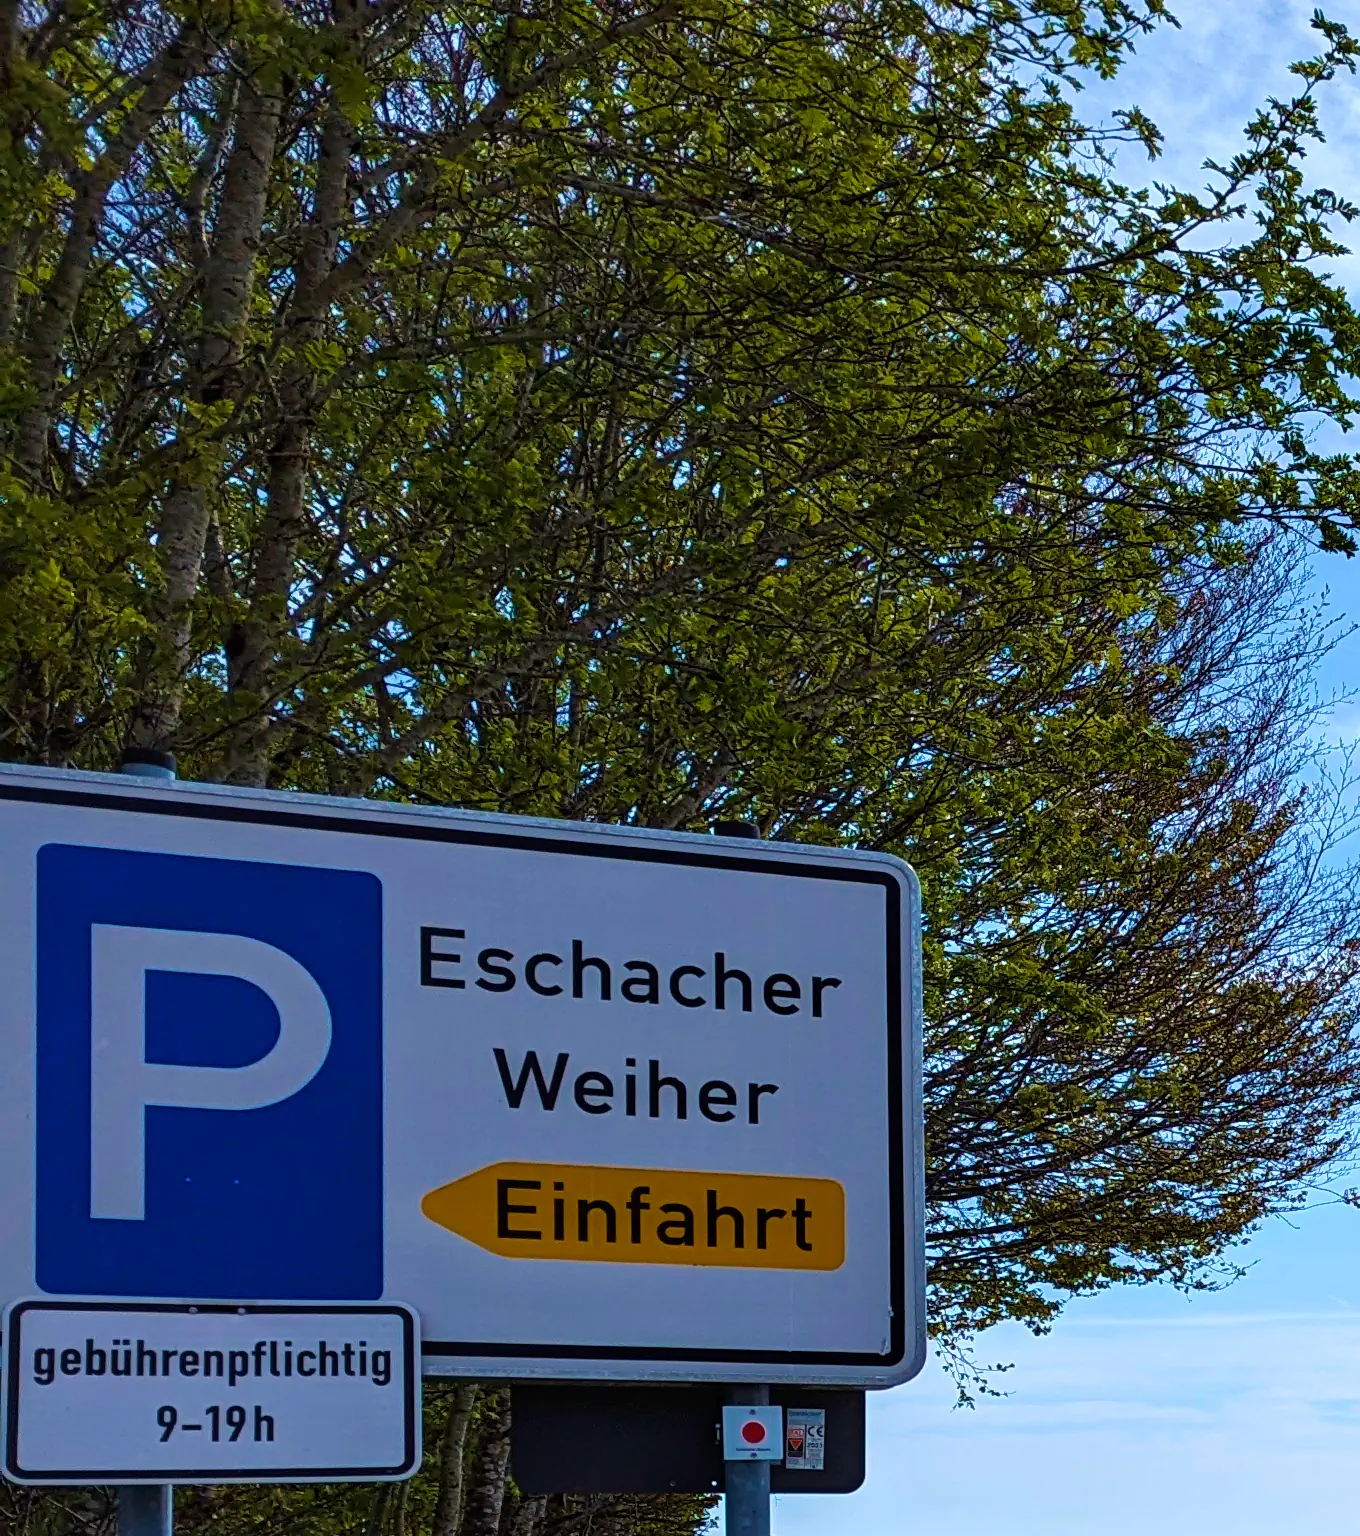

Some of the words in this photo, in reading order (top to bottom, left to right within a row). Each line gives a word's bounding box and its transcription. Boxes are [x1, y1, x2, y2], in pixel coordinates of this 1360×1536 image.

[419, 926, 842, 1018] Eschacher
[90, 923, 332, 1220] P
[493, 1047, 779, 1125] Weiher
[496, 1179, 813, 1253] Einfahrt
[33, 1338, 391, 1386] gebührenpflichtig
